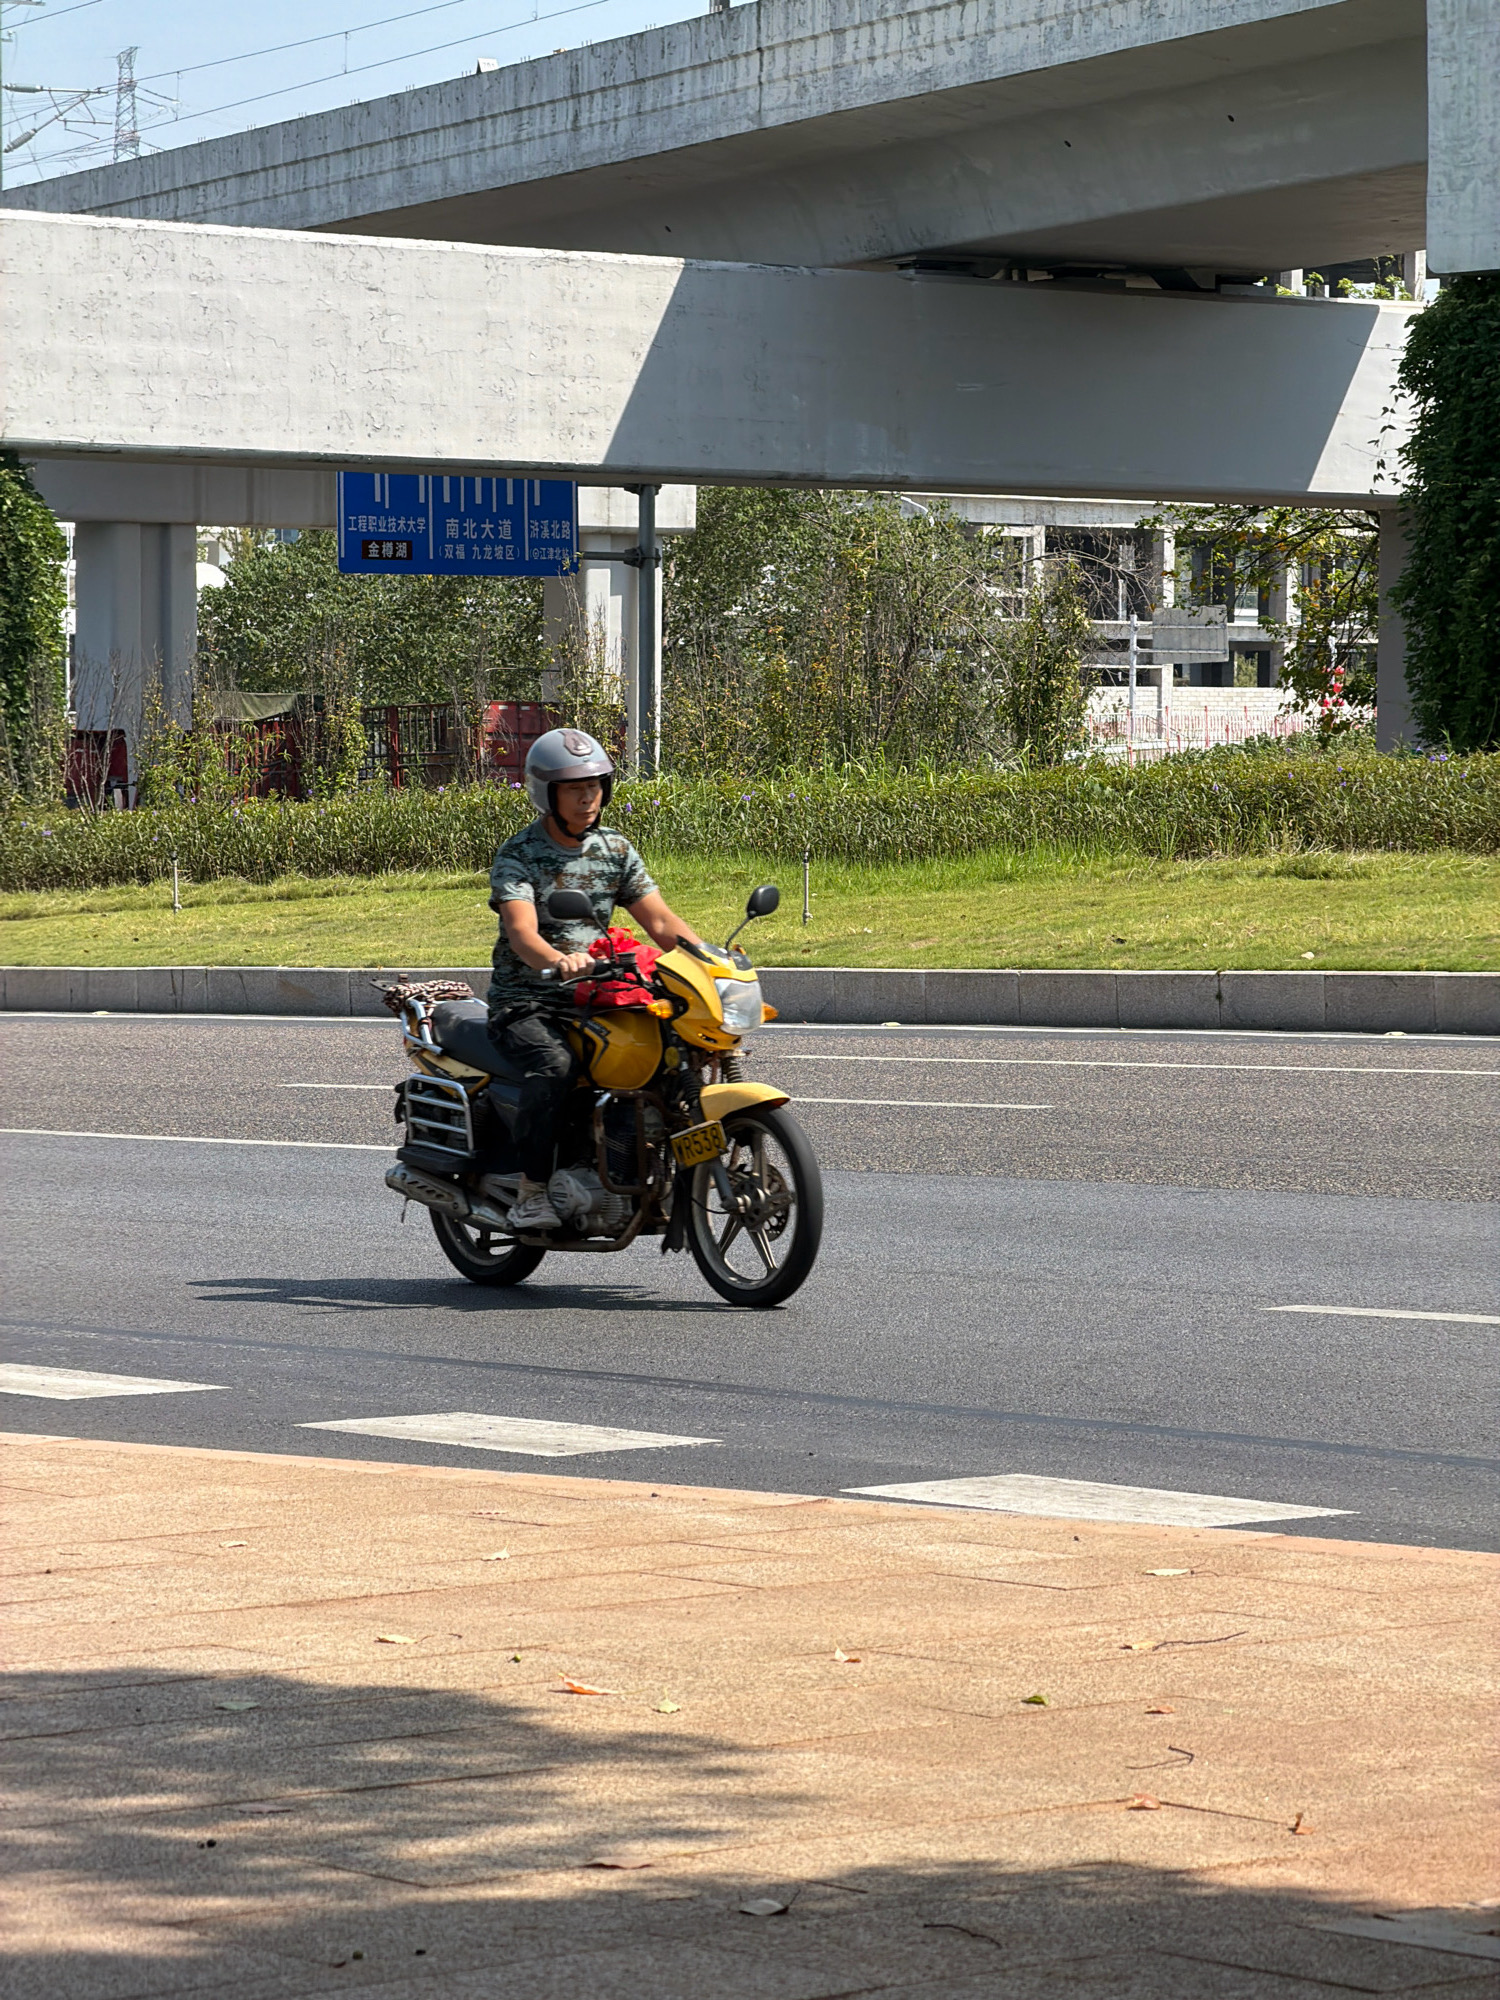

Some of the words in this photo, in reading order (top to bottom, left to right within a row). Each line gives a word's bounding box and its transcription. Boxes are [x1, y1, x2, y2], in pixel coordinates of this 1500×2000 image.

[348, 515, 426, 533] 工程职业技术大学
[445, 518, 512, 540] 南北大道
[368, 541, 408, 558] 金樽湖
